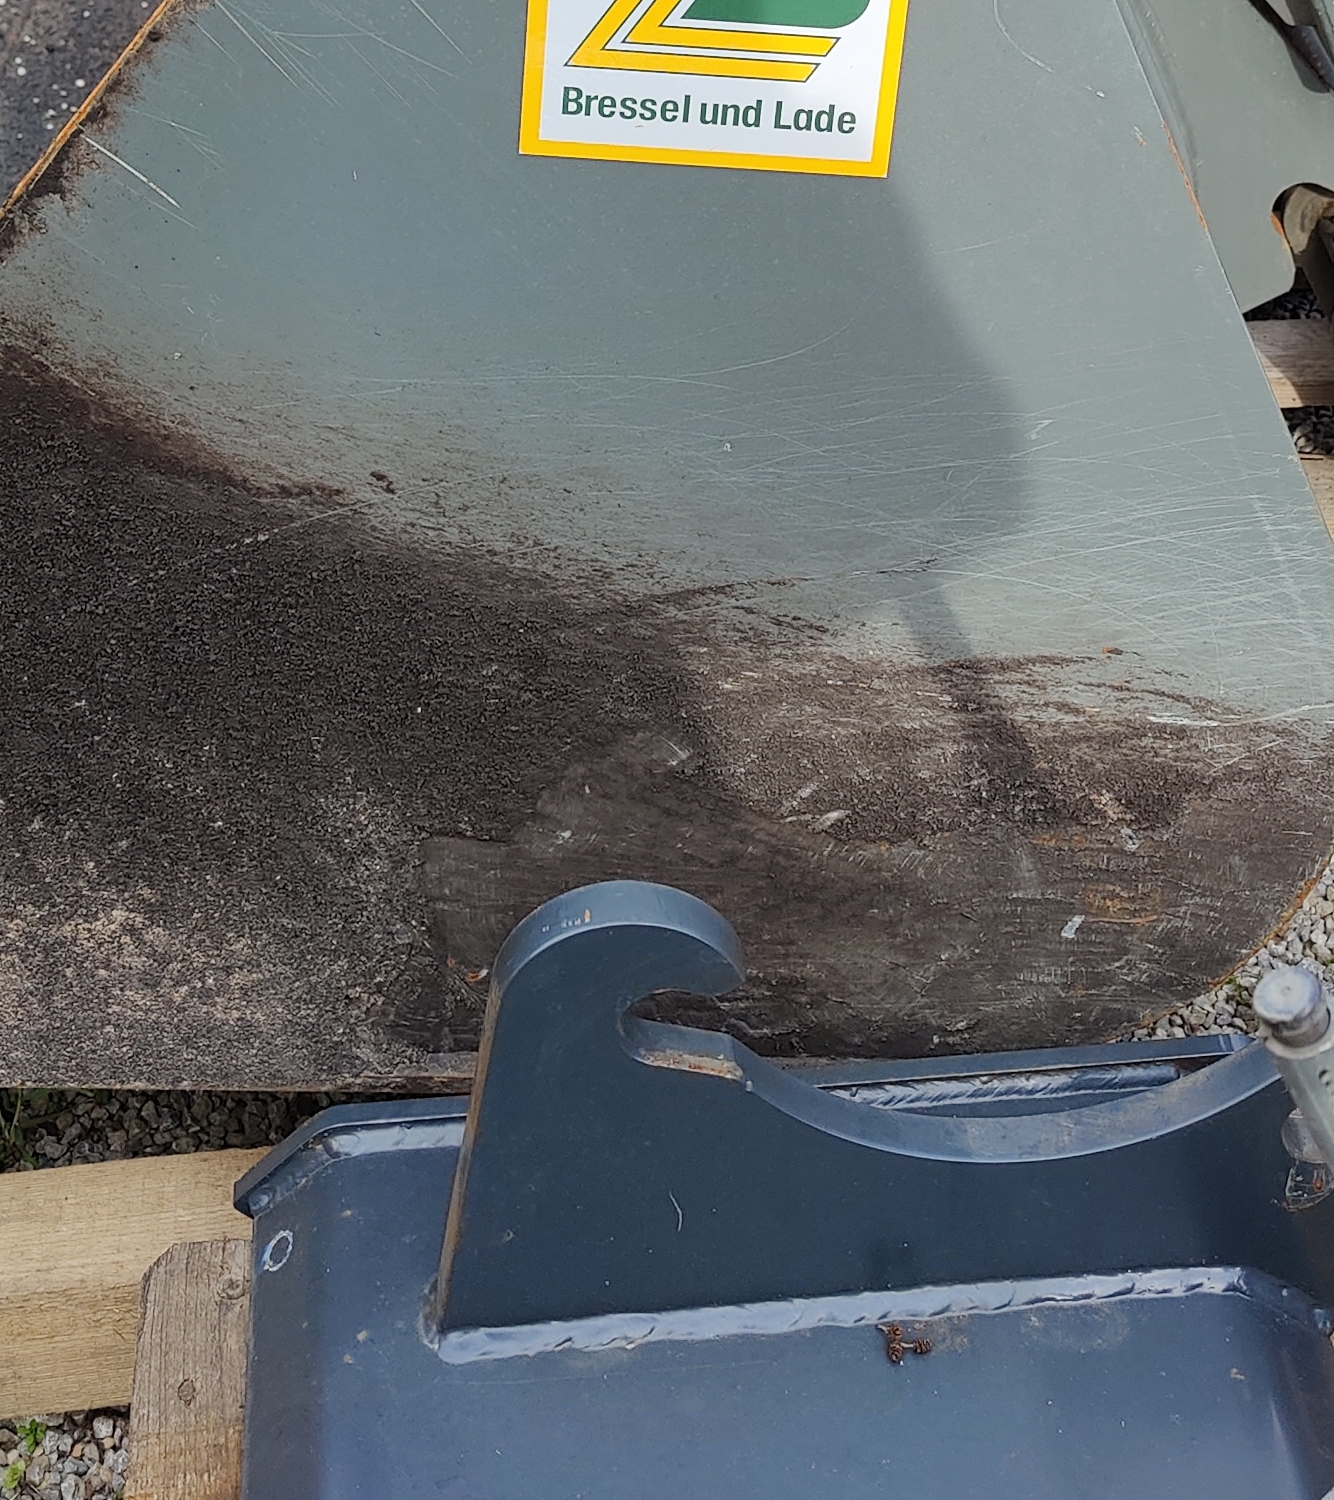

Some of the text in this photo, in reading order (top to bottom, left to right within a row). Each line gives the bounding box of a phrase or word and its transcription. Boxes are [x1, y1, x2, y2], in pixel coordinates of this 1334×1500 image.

[561, 85, 857, 135] Bressel und Lade
